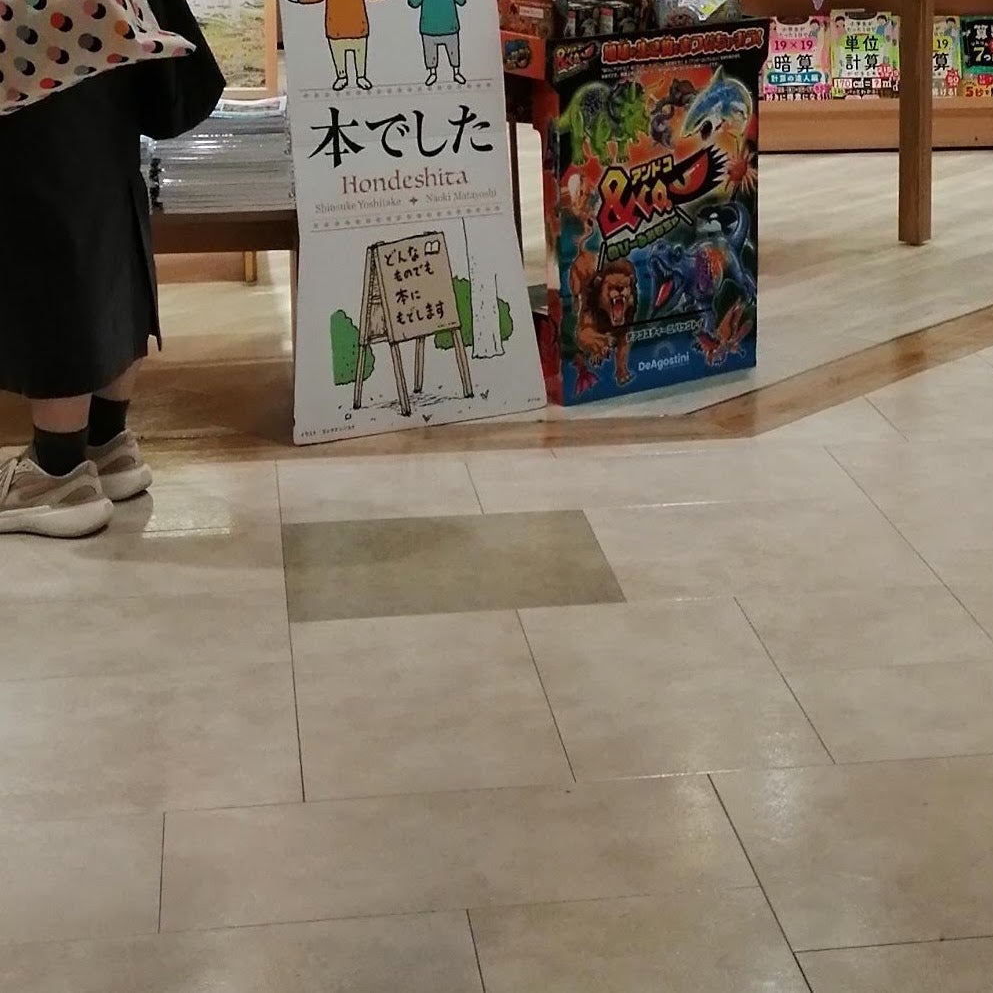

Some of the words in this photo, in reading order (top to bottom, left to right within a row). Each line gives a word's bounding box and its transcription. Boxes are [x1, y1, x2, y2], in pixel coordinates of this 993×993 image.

[844, 35, 880, 53] 単位
[773, 53, 815, 74] 暗算
[844, 53, 880, 71] 計算
[308, 104, 495, 169] 本でした
[341, 166, 469, 195] Hondeshita
[383, 245, 420, 267] どんな
[394, 260, 435, 283] ものでも
[395, 288, 421, 306] 本に
[638, 352, 690, 372] DeAgostini
